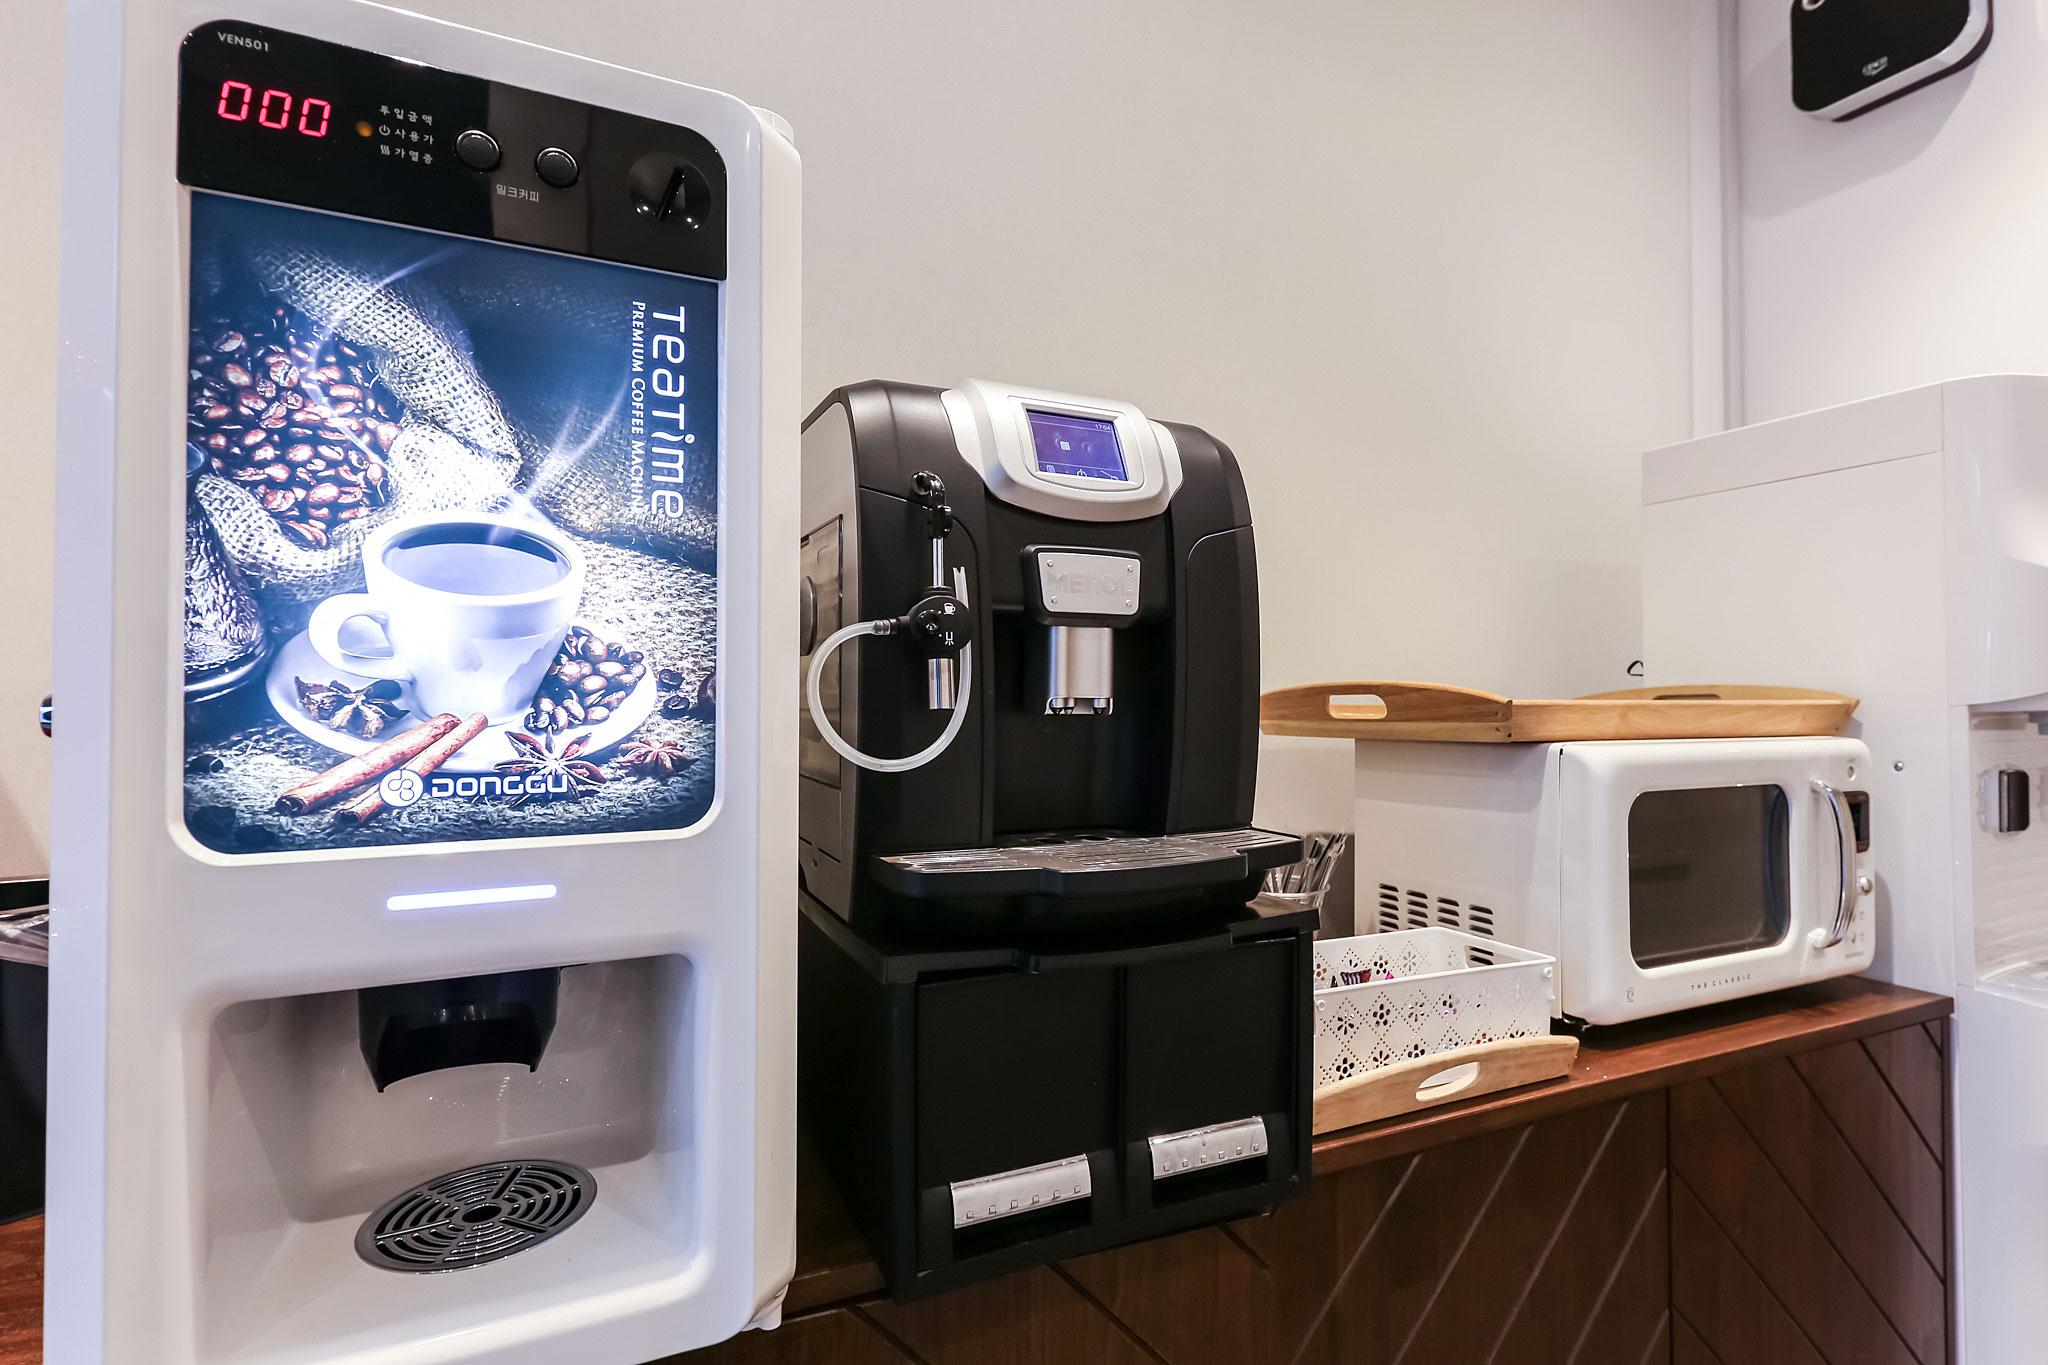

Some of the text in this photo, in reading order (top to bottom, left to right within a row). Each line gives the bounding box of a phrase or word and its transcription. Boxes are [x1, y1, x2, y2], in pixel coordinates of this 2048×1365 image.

[217, 31, 269, 52] VEN501
[217, 80, 331, 138] 000
[496, 184, 539, 202] 밀크커피
[632, 300, 646, 372] PREMIUM
[631, 377, 645, 435] COFFEE
[431, 774, 568, 798] DONGGU
